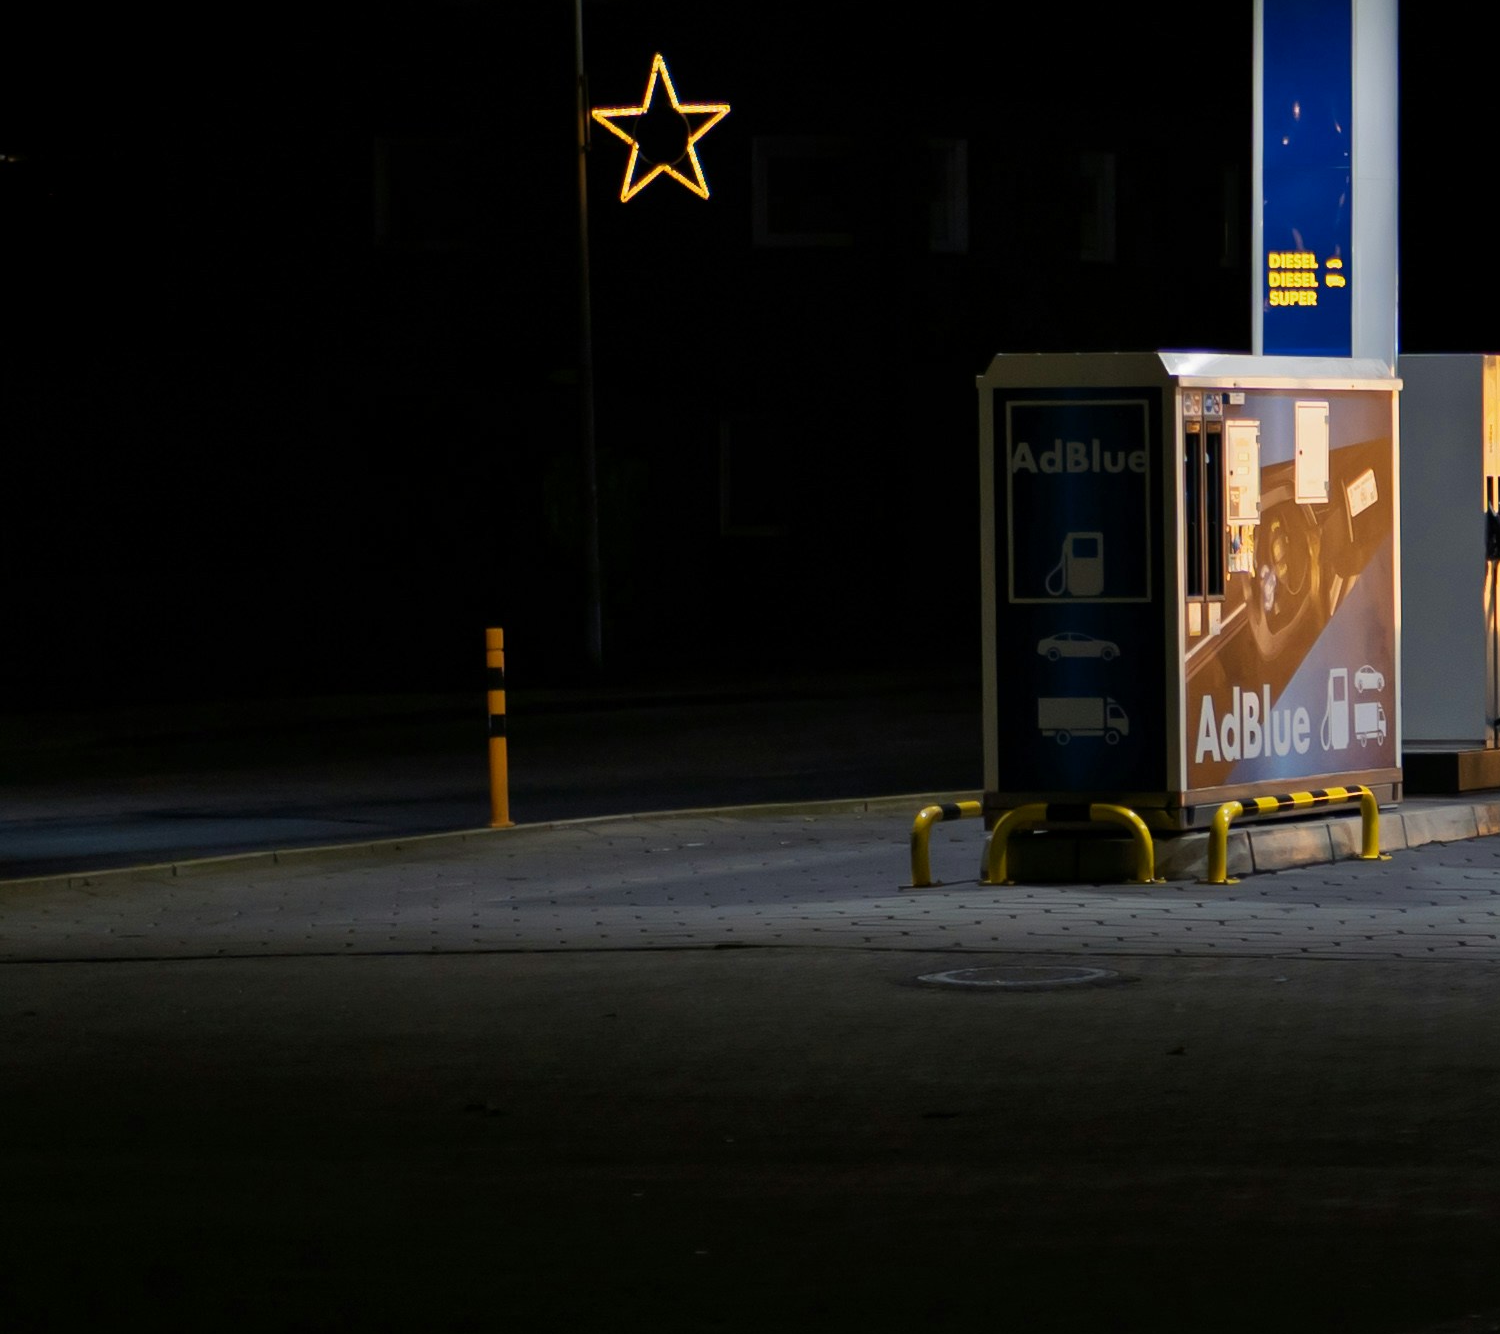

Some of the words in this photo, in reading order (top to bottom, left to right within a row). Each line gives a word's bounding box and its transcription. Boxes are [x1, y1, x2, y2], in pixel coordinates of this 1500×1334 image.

[1268, 252, 1319, 269] DIESEL
[1268, 271, 1319, 288] DIESEL
[1269, 290, 1318, 306] SUPER
[1011, 438, 1149, 474] AdBlue
[1195, 684, 1311, 763] AdBlue
